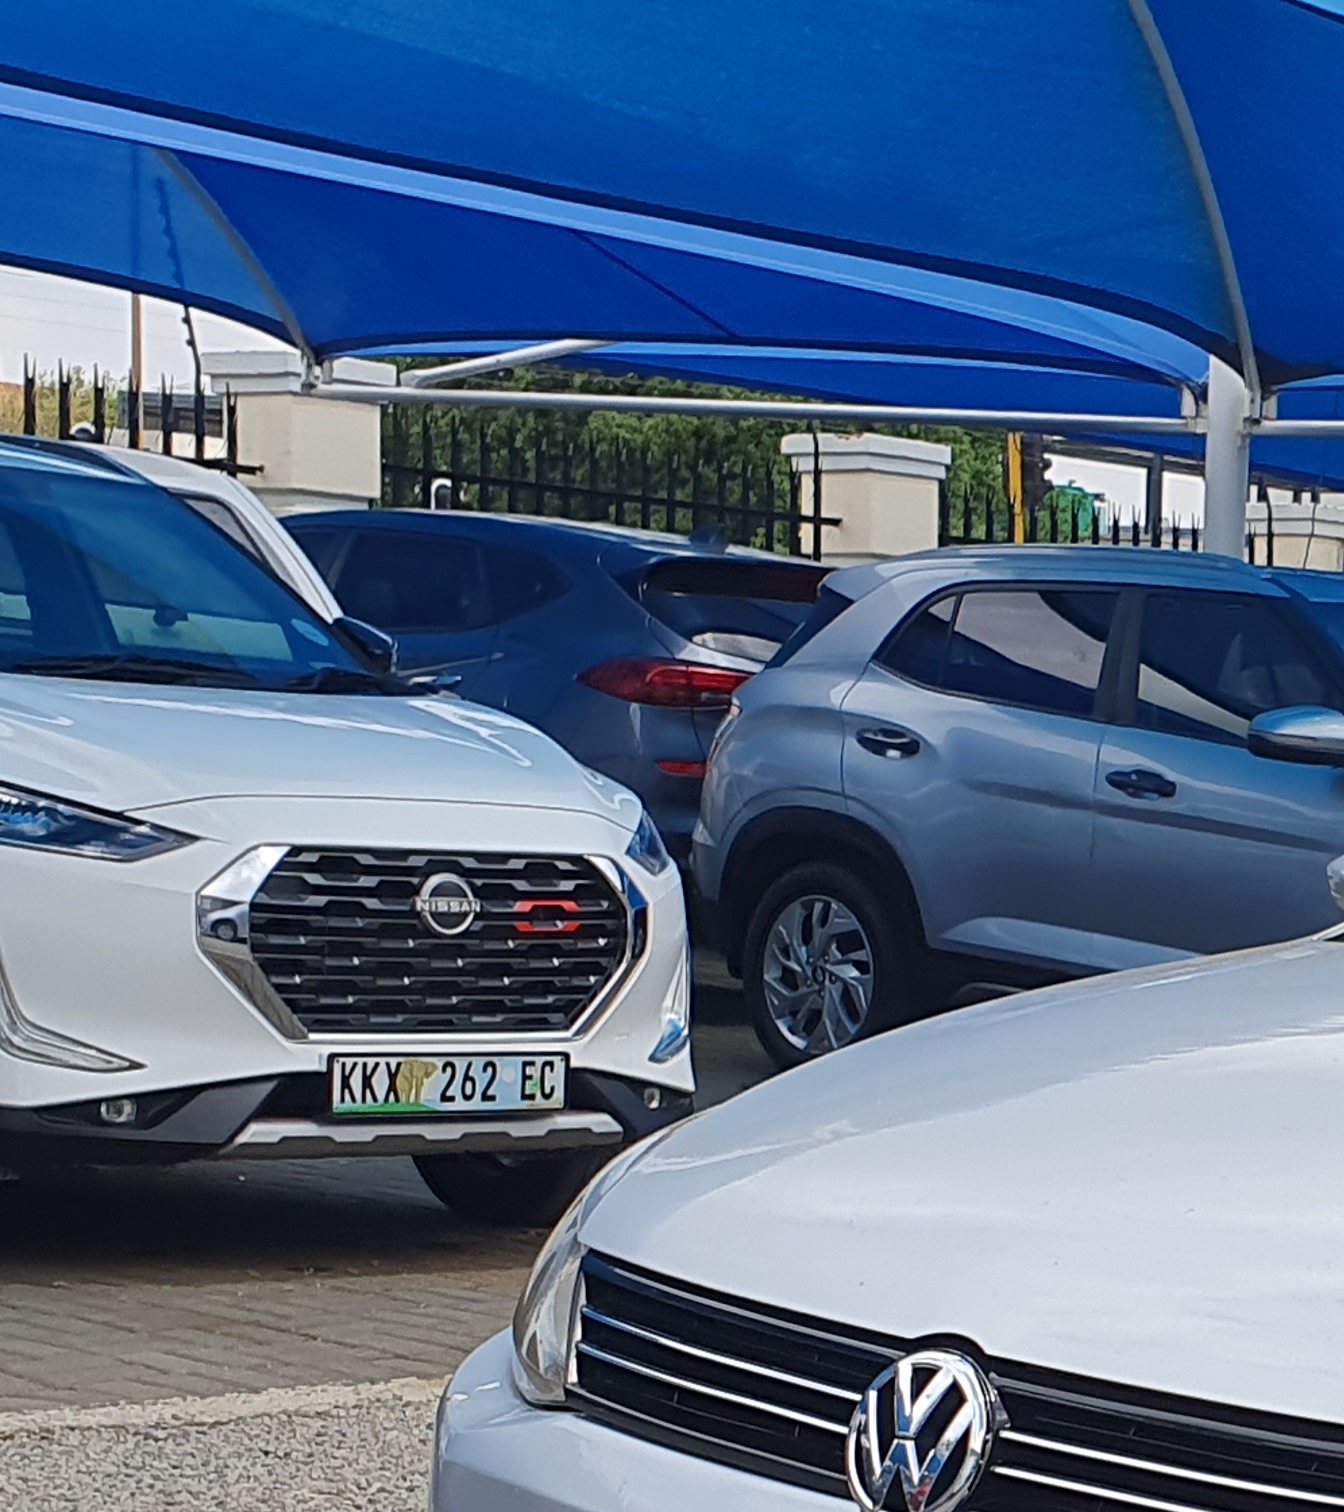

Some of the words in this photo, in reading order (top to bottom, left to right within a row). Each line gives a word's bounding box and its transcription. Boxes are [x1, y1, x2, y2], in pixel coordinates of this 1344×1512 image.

[415, 899, 482, 913] NISSAN
[340, 1061, 403, 1104] KKX
[439, 1061, 498, 1102] 262
[521, 1061, 556, 1100] EC
